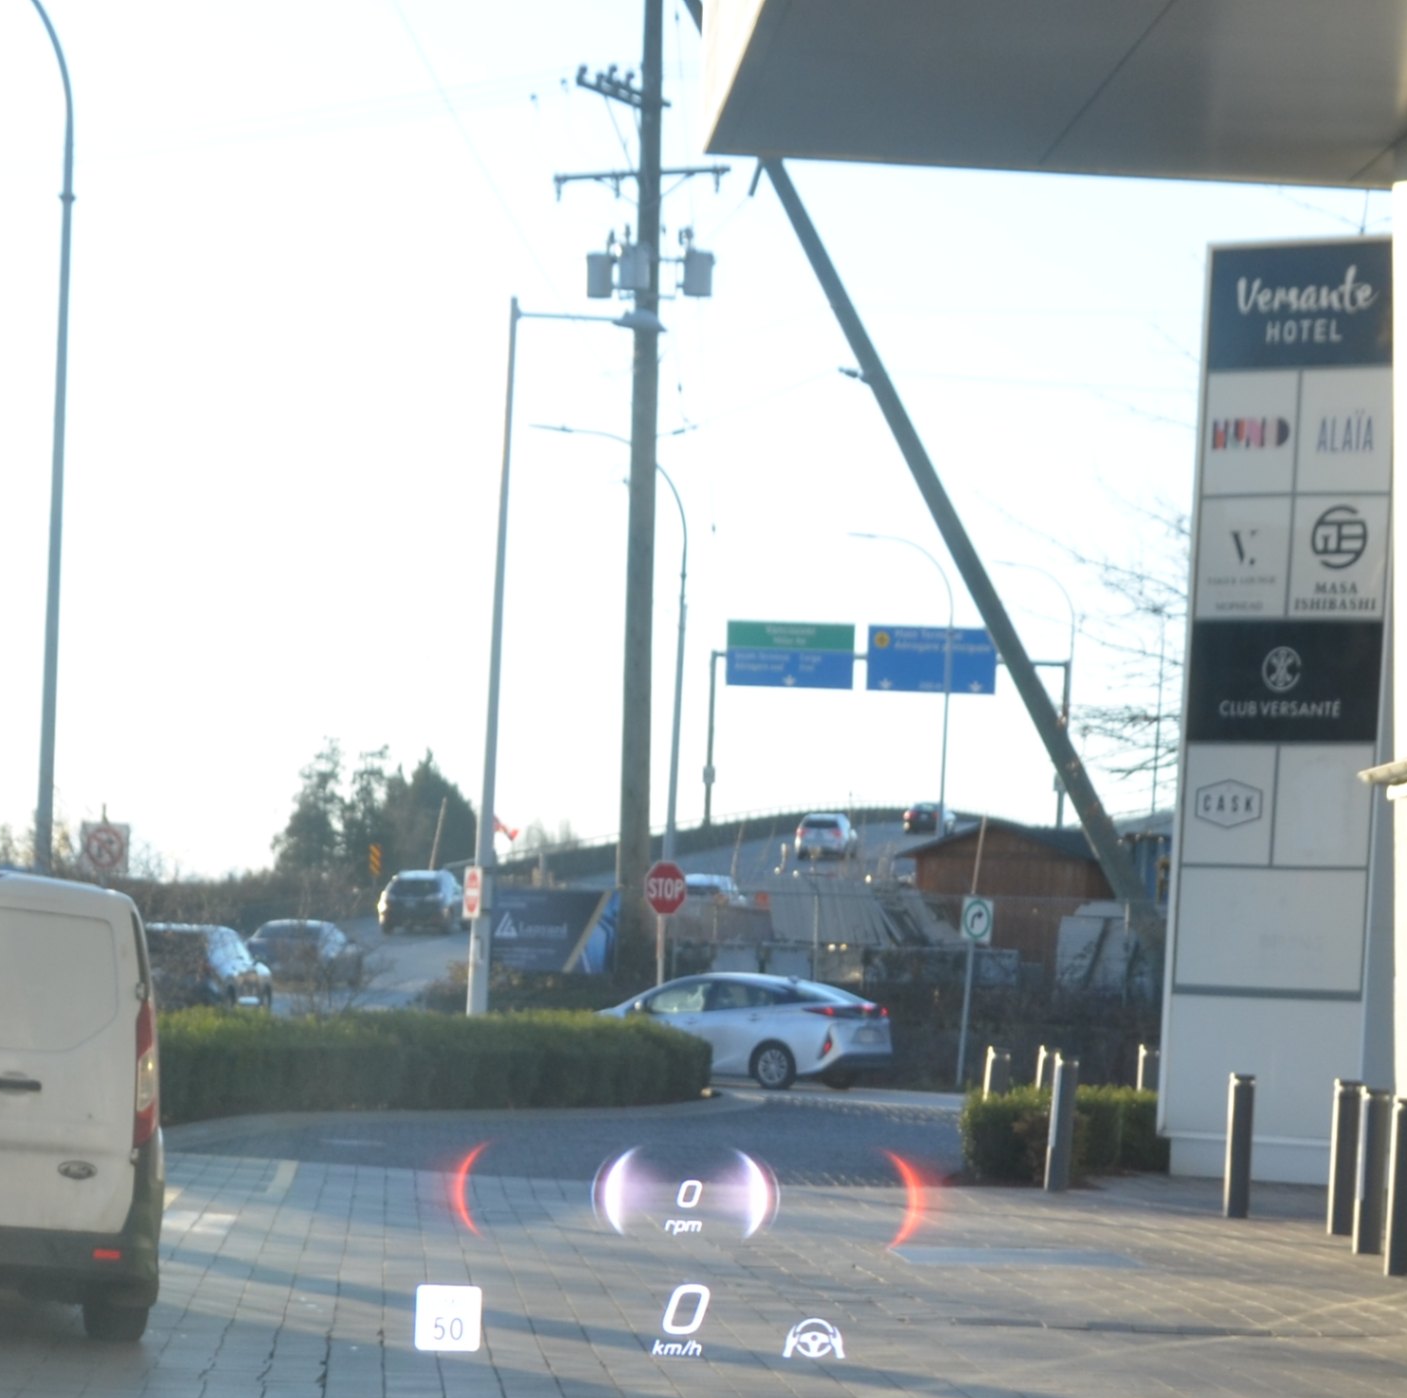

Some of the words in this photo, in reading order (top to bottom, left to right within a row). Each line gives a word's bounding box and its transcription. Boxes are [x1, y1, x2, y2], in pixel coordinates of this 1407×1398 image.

[1236, 264, 1380, 315] Versante
[1265, 318, 1342, 344] HOTEL
[1316, 409, 1375, 452] ALAÏA
[1314, 581, 1358, 595] MASA
[1294, 597, 1377, 612] ISHIBASHI
[1219, 699, 1258, 718] CLUB
[1203, 793, 1254, 813] CASK
[648, 877, 684, 899] STOP
[677, 1180, 703, 1208] 0
[665, 1219, 702, 1235] rpm
[662, 1284, 711, 1335] 0
[433, 1316, 464, 1341] 50
[652, 1339, 702, 1357] km/h
